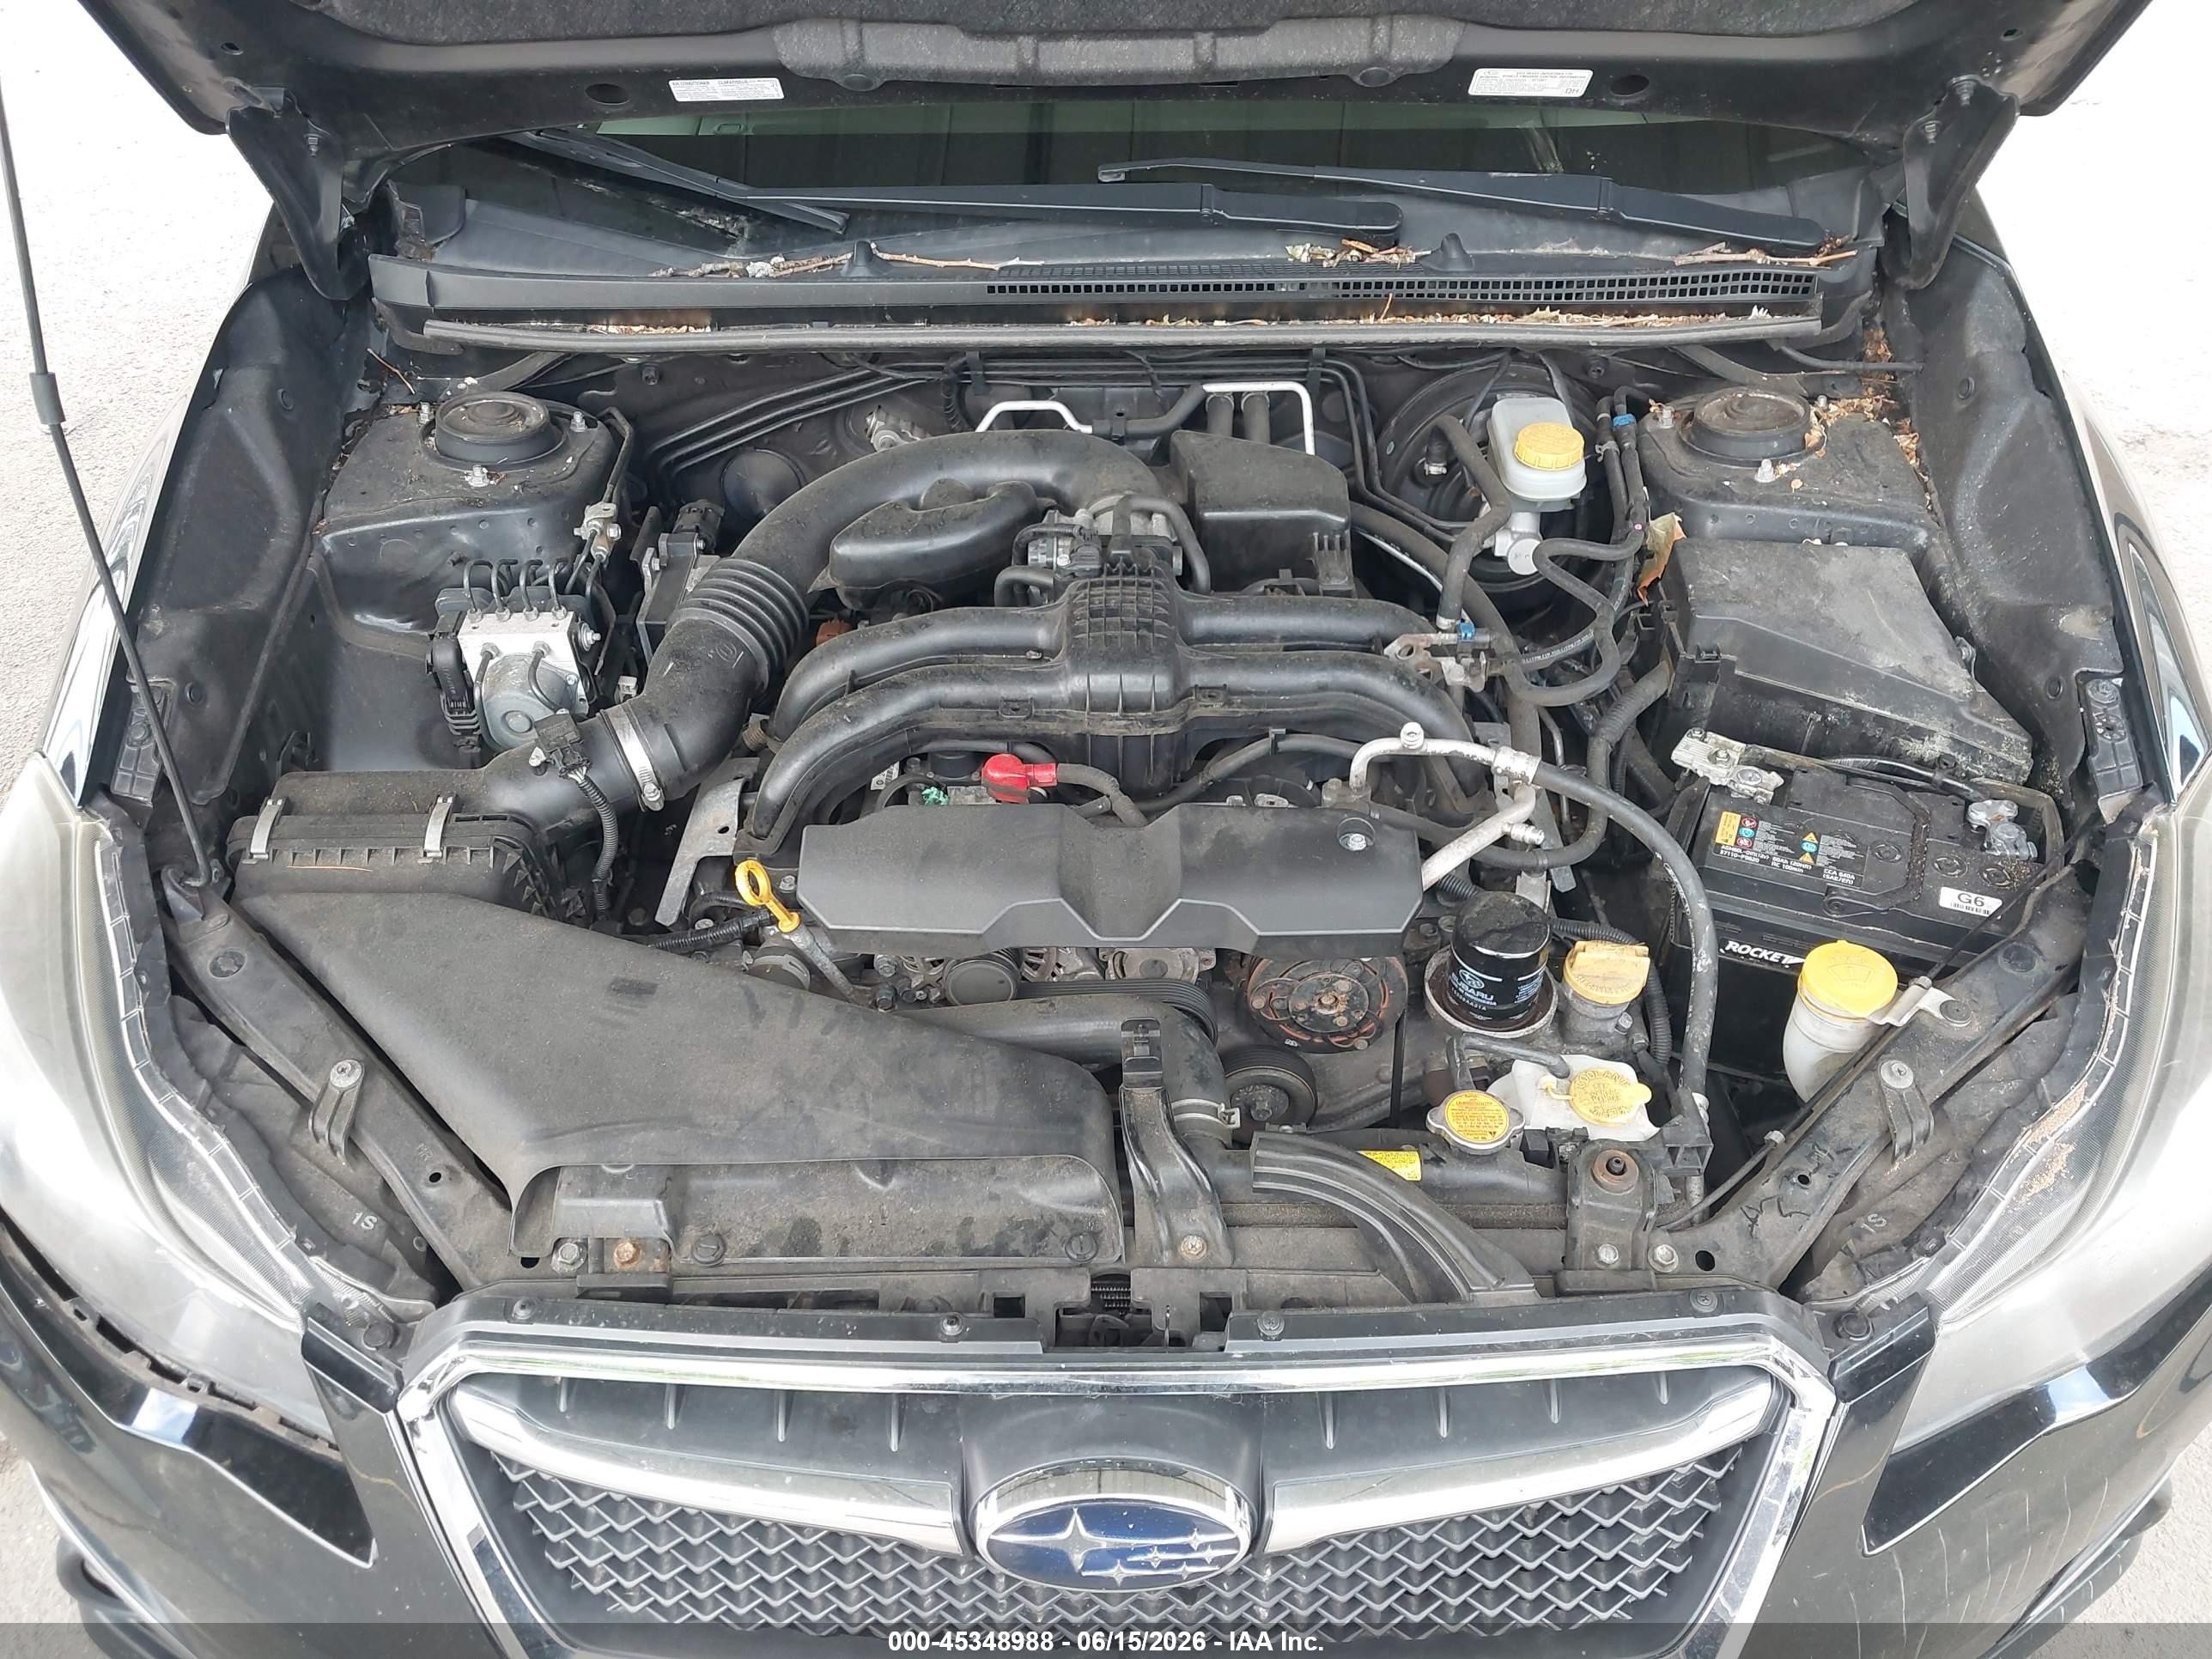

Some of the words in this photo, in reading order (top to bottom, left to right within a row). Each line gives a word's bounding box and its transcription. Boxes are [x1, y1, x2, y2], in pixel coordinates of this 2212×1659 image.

[1823, 868, 1837, 877] CCA
[1958, 892, 1984, 907] G6
[1725, 940, 1802, 964] ROCKET
[1451, 972, 1494, 1000] SUBARU
[1577, 1070, 1631, 1090] COOLANT
[352, 1212, 378, 1231] 1S
